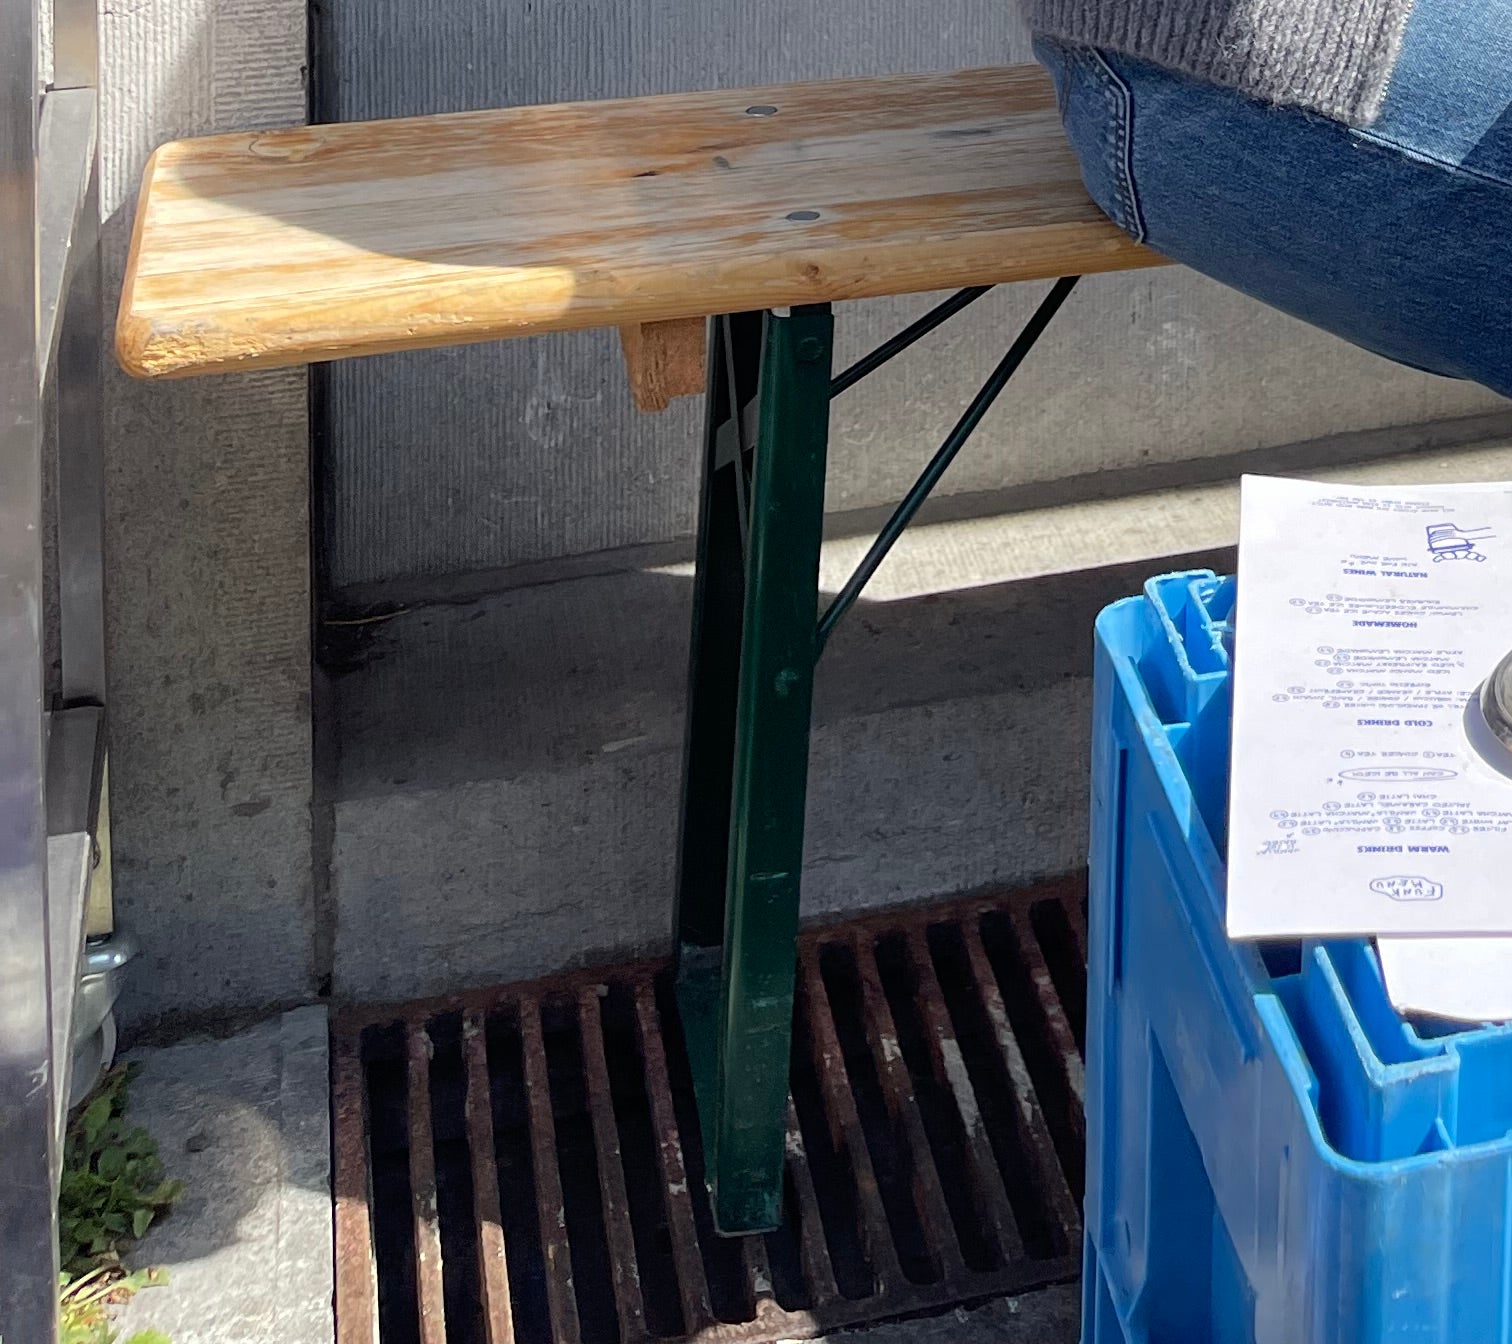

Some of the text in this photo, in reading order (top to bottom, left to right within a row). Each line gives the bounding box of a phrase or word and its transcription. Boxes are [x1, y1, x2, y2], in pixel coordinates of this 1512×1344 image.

[1342, 568, 1428, 579] NATURAL WINES
[1352, 620, 1418, 629] HOMEMADE
[1404, 719, 1433, 727] COLD
[1356, 845, 1450, 854] WARM DRINKS
